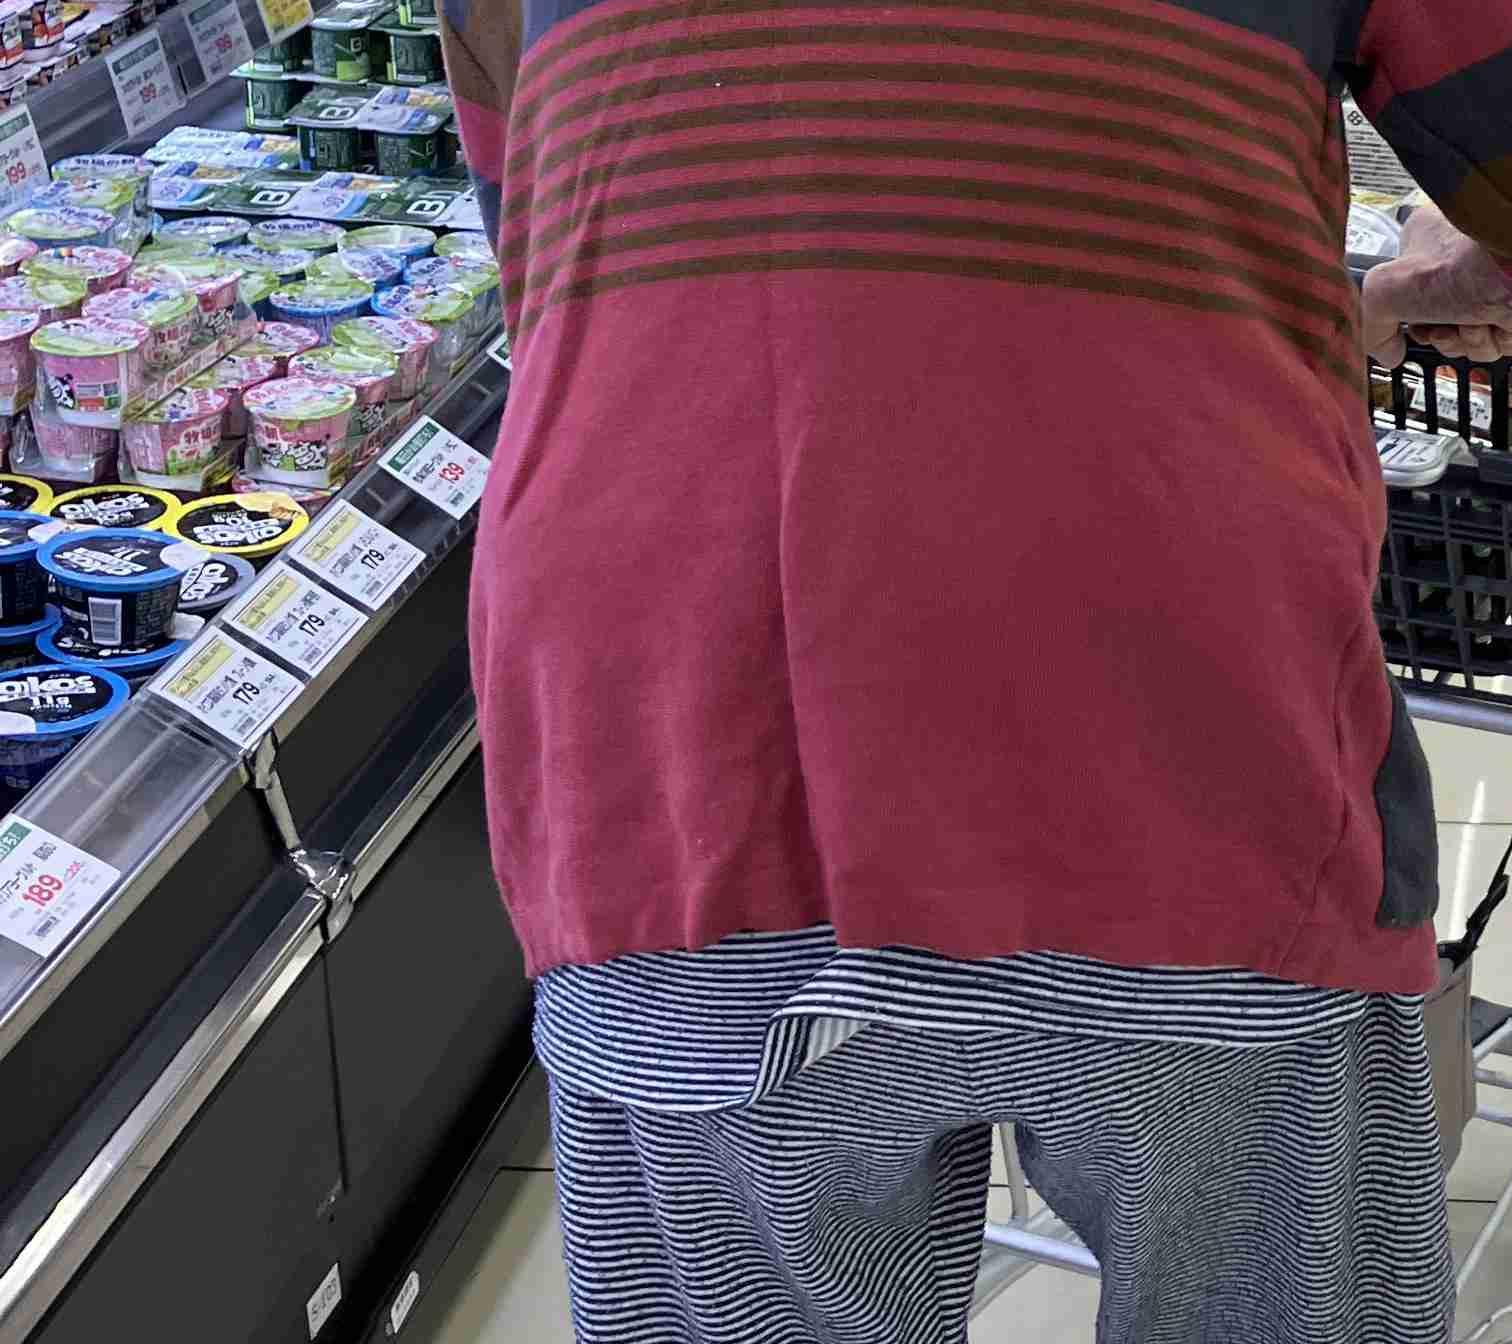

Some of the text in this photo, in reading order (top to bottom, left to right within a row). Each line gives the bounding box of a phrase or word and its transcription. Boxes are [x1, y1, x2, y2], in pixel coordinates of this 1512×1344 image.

[439, 462, 465, 485] 139
[361, 548, 385, 570] 179
[299, 614, 325, 637] 179
[233, 681, 260, 705] 179
[22, 874, 63, 908] 189
